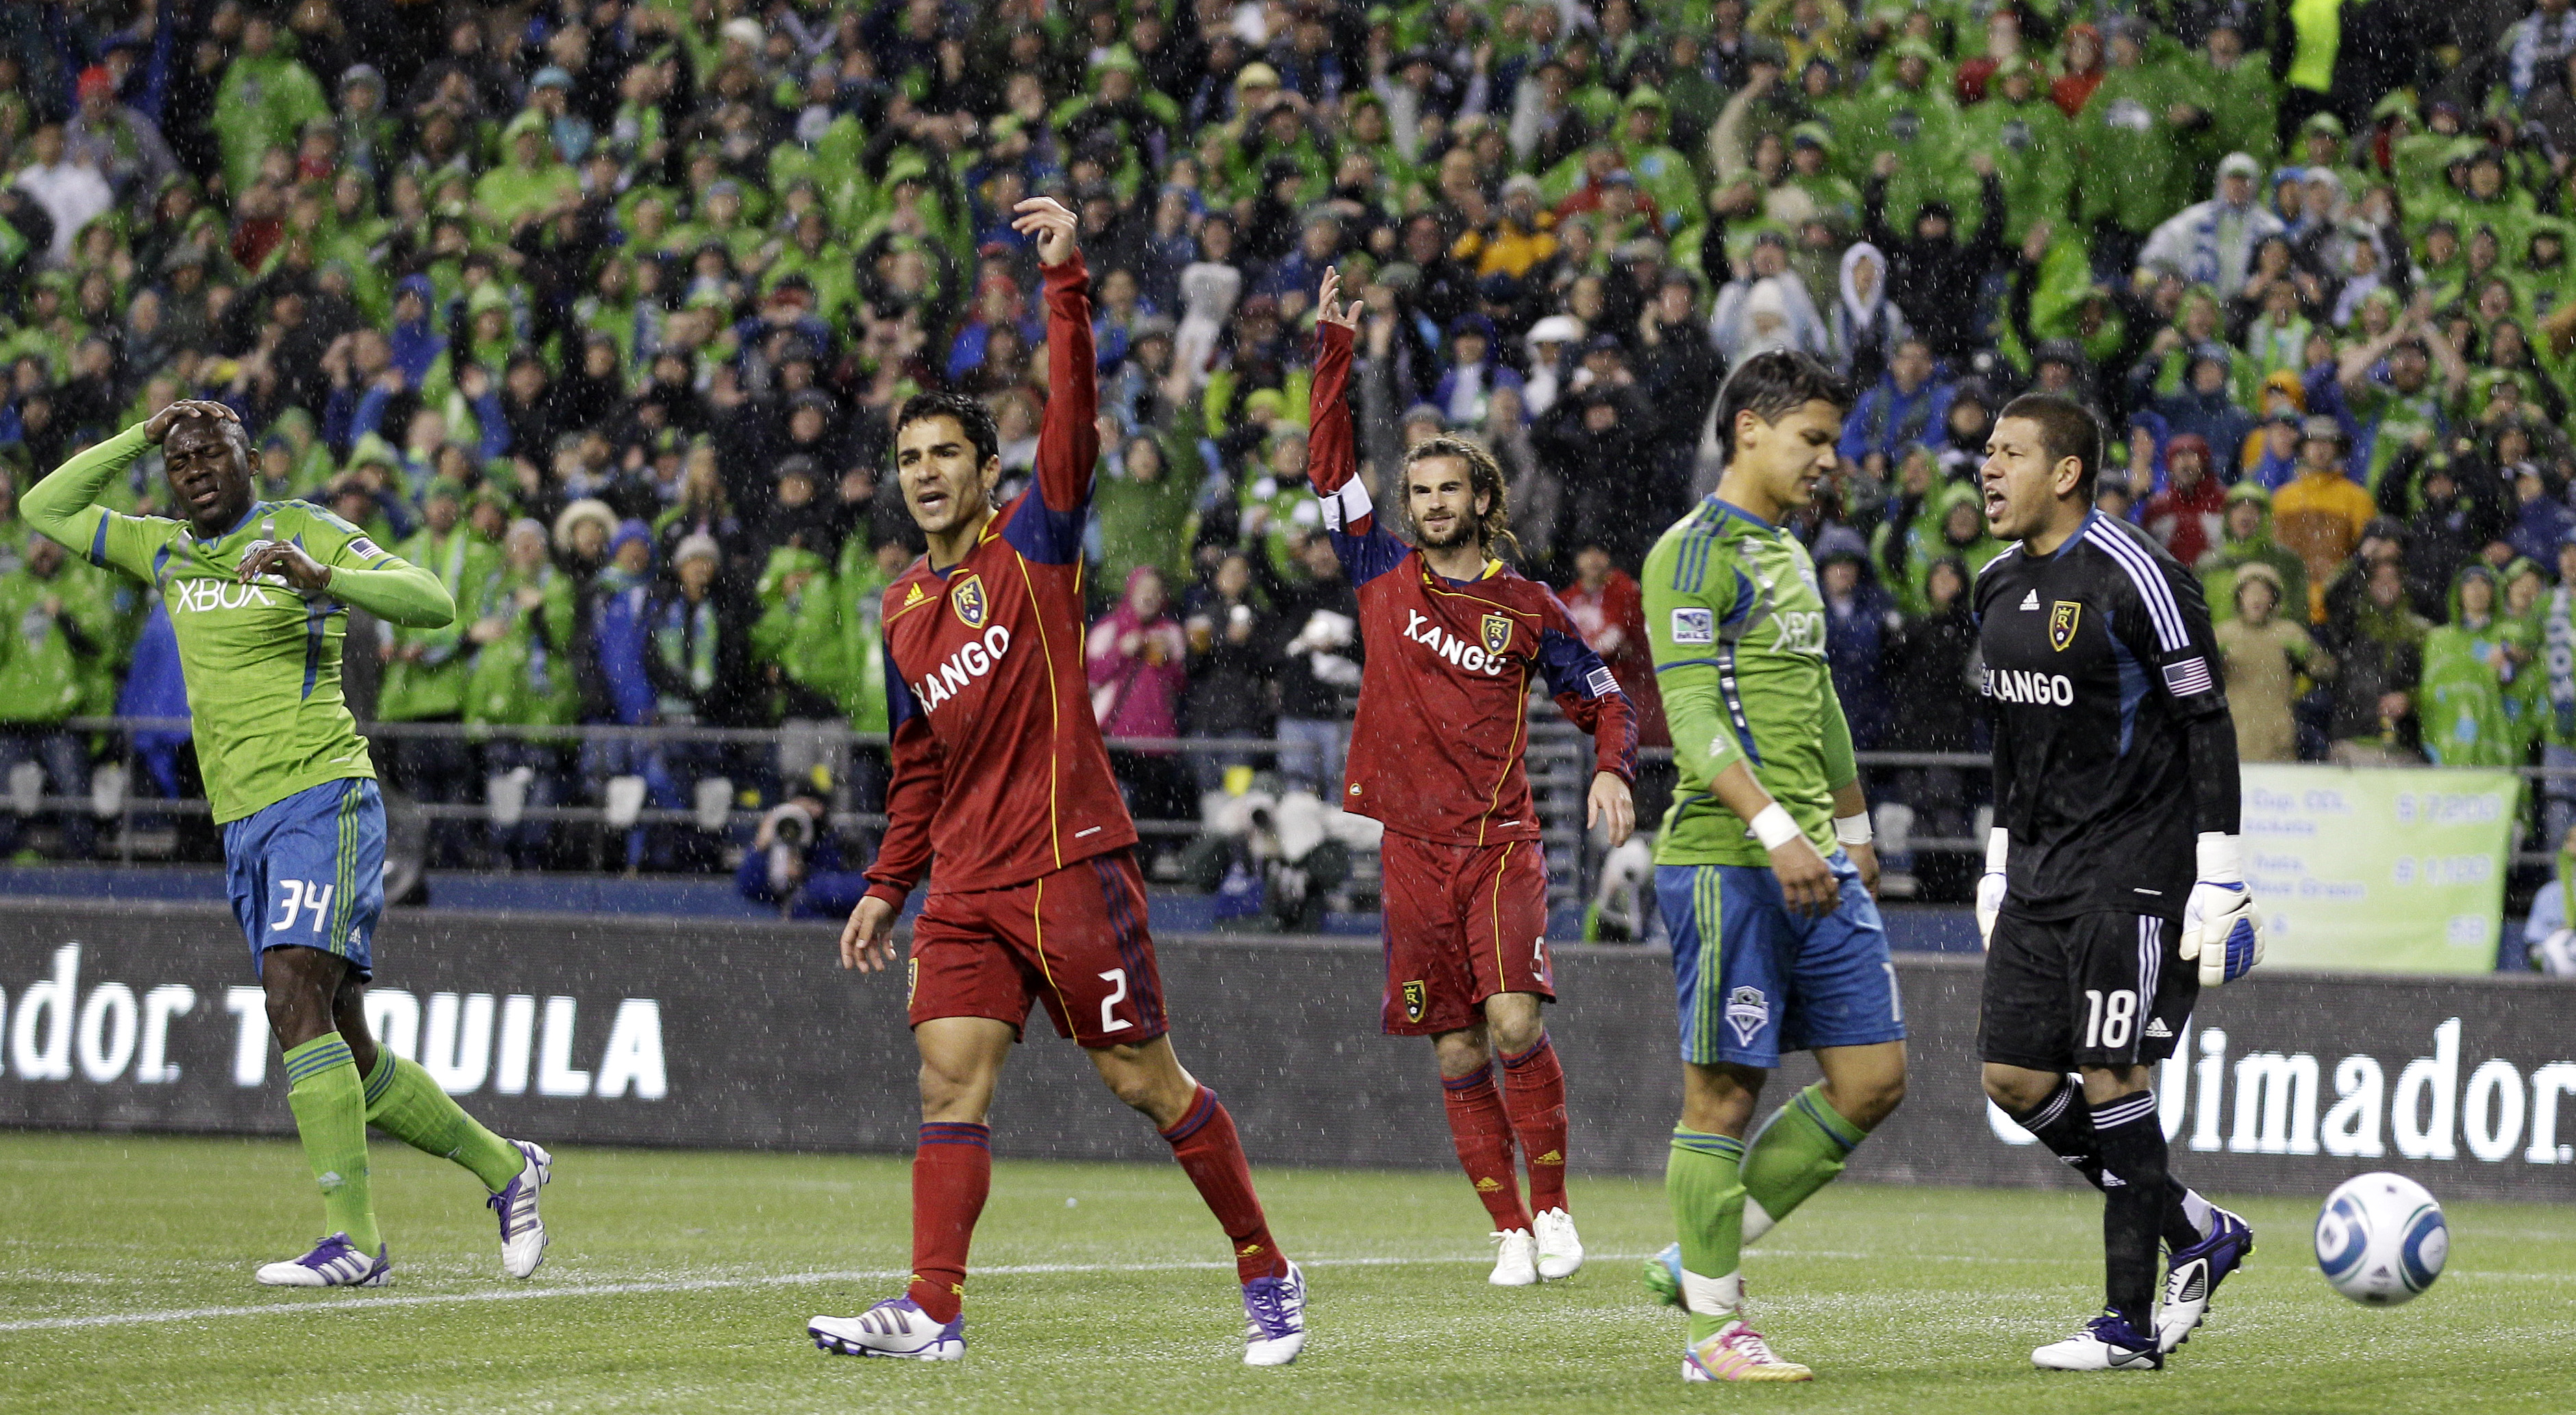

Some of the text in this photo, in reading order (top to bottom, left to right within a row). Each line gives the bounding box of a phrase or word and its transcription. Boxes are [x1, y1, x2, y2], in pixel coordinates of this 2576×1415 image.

[271, 873, 335, 932] 34
[1097, 968, 1134, 1033] 2
[2085, 989, 2138, 1048] 18
